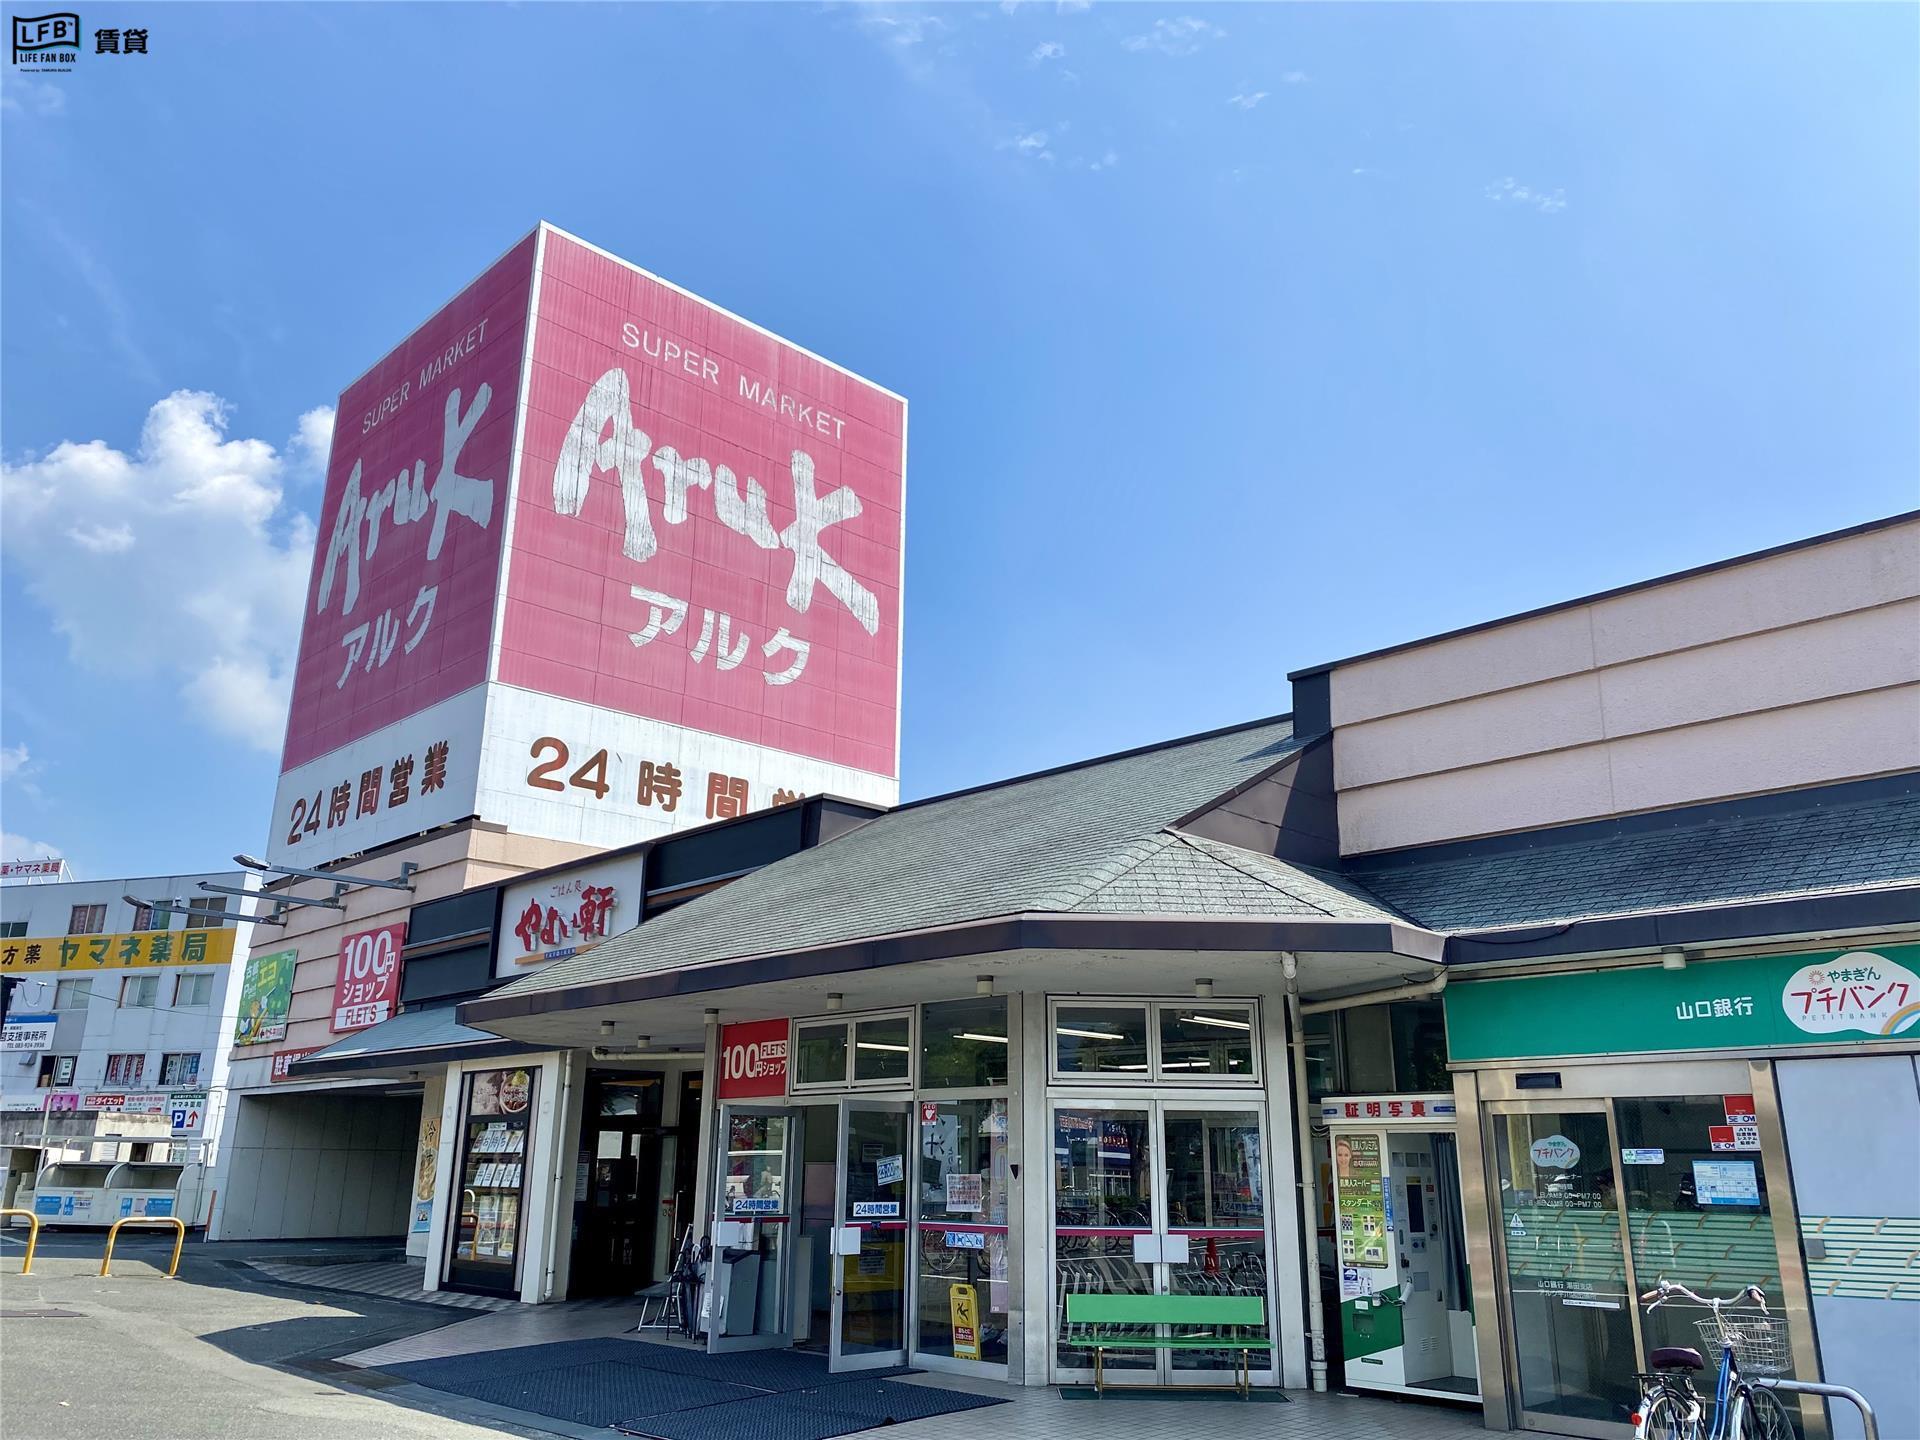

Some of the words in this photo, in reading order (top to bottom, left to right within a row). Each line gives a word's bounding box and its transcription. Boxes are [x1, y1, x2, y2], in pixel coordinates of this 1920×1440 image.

[362, 380, 411, 435] SUPER
[418, 318, 489, 391] MARKET
[621, 321, 720, 387] SUPER
[738, 374, 848, 442] MARKET
[336, 584, 440, 691] アルク
[627, 584, 811, 687] アルク
[286, 740, 451, 846] 24時間営業
[58, 932, 209, 968] ヤマネ薬局
[1827, 966, 1881, 984] やまぎん
[342, 974, 389, 1005] ショップ
[1791, 982, 1910, 1014] プチバンク
[1675, 996, 1754, 1020] 山口銀行
[95, 1096, 124, 1106] ダイエット
[1345, 1101, 1426, 1118] 証明写真
[173, 1112, 184, 1128] P
[1728, 1115, 1756, 1123] SEOM
[734, 1199, 779, 1210] 24時間営業
[855, 1203, 897, 1215] 24時間営業
